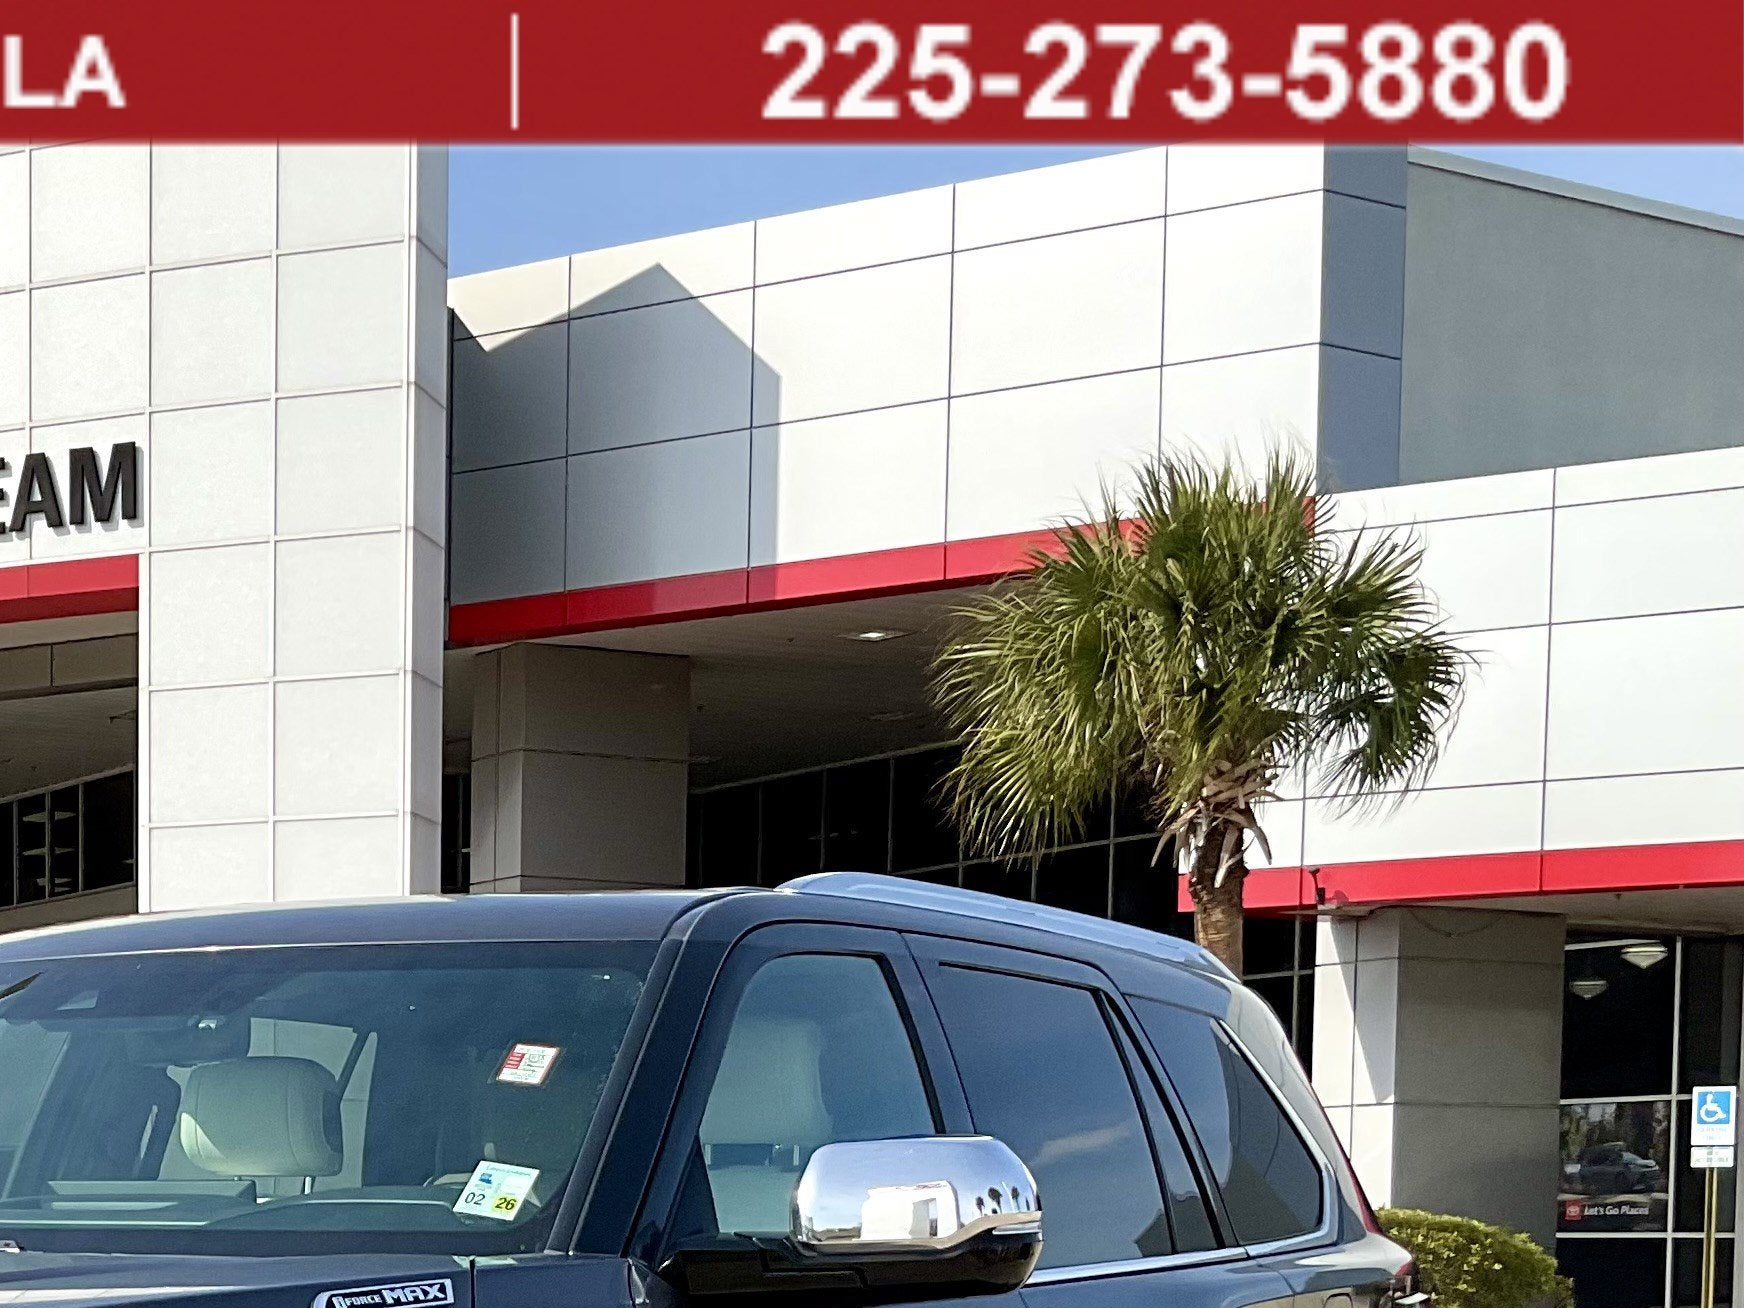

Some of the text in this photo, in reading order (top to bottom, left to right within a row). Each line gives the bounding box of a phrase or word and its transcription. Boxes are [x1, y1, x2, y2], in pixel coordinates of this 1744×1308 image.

[465, 1192, 485, 1205] 02
[495, 1197, 516, 1210] 26
[1584, 1205, 1604, 1215] Let's
[1605, 1205, 1619, 1215] Go
[382, 1284, 446, 1304] MAX
